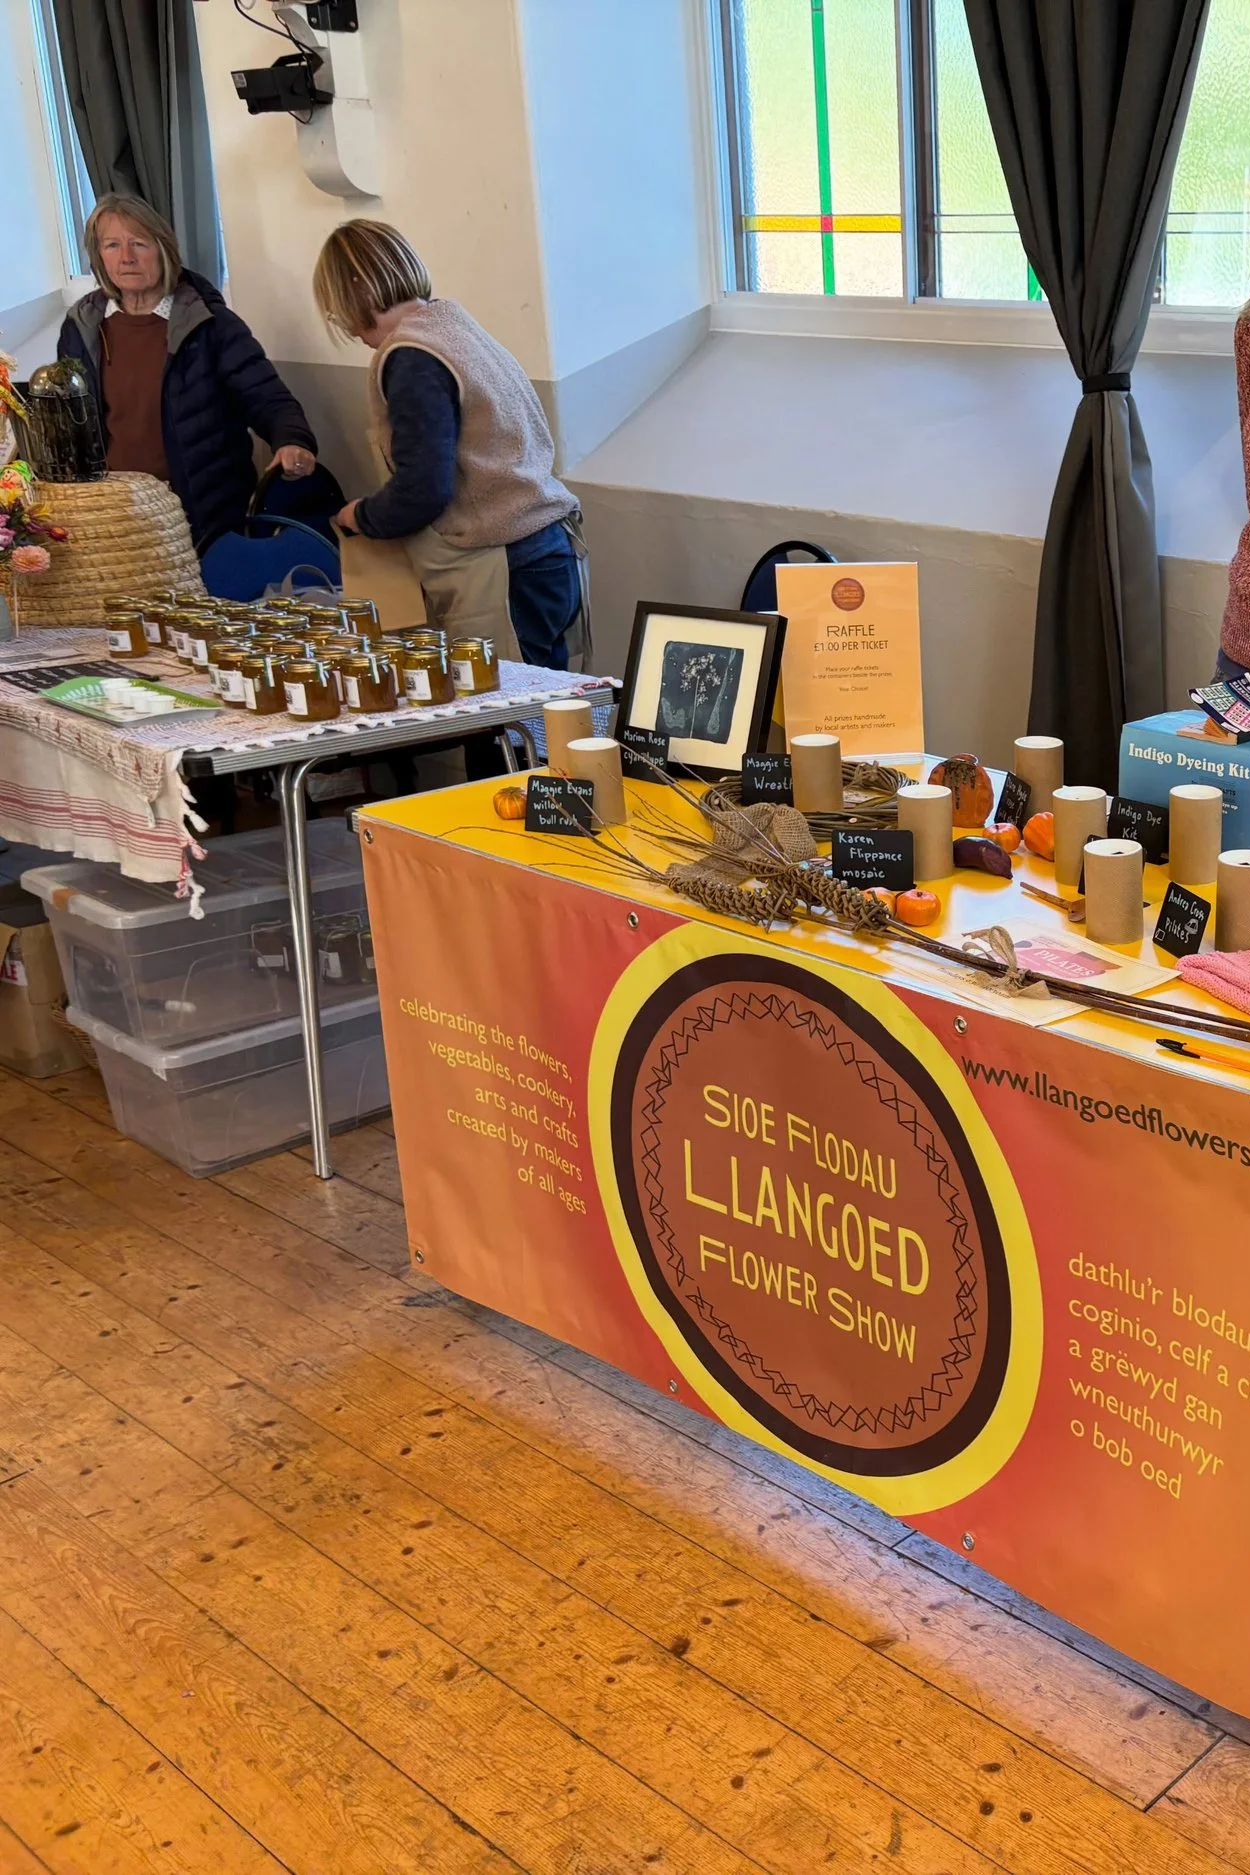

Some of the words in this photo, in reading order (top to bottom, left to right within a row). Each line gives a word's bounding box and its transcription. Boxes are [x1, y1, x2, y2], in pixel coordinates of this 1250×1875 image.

[827, 625, 875, 637] RAFFLE
[842, 642, 858, 650] PER
[861, 640, 888, 650] TICKET
[835, 714, 852, 723] prizes
[854, 713, 886, 721] handmade
[624, 730, 646, 743] Marion
[649, 732, 666, 746] Rose
[747, 758, 778, 772] Maggie
[1129, 743, 1172, 764] Indigo
[1177, 752, 1224, 777] Dyeing
[1228, 763, 1250, 779] Kit
[531, 781, 562, 796] Maggie
[568, 784, 593, 796] Evans
[1118, 803, 1142, 825] Indigo
[1146, 809, 1162, 825] Dye
[838, 832, 874, 846] Karen
[1122, 827, 1138, 840] Kit
[842, 868, 885, 879] mosaic
[850, 848, 902, 863] Flippance
[1166, 918, 1189, 944] Pilates
[1034, 950, 1095, 976] PILATES
[400, 998, 487, 1044] celebrating
[490, 1025, 515, 1051] the
[519, 1035, 572, 1083] flowers,
[428, 1040, 515, 1085] vegetables,
[518, 1073, 576, 1118] cookery,
[475, 1087, 506, 1110] arts
[511, 1105, 537, 1125] and
[544, 1116, 578, 1149] crafts
[447, 1108, 506, 1142] created
[511, 1127, 528, 1156] by
[535, 1143, 582, 1181] makers
[703, 1084, 776, 1145] SIOE
[787, 1112, 897, 1199] FLODAU
[518, 1166, 534, 1184] of
[539, 1174, 554, 1194] all
[559, 1186, 586, 1214] ages
[685, 1139, 930, 1295] LLANGOED
[1069, 1252, 1163, 1305] dathlu’r
[700, 1234, 819, 1314] FLOWER
[828, 1287, 916, 1364] SHOW
[1069, 1299, 1162, 1354] coginio,
[1170, 1340, 1212, 1374] celf
[1217, 1364, 1229, 1386] a
[1069, 1339, 1081, 1358] a
[1091, 1348, 1177, 1403] grëwyd
[1183, 1394, 1222, 1430] gan
[1069, 1377, 1224, 1475] wneuthurwyr
[1070, 1419, 1084, 1437] o
[1093, 1422, 1132, 1466] bob
[1141, 1460, 1182, 1500] oed
